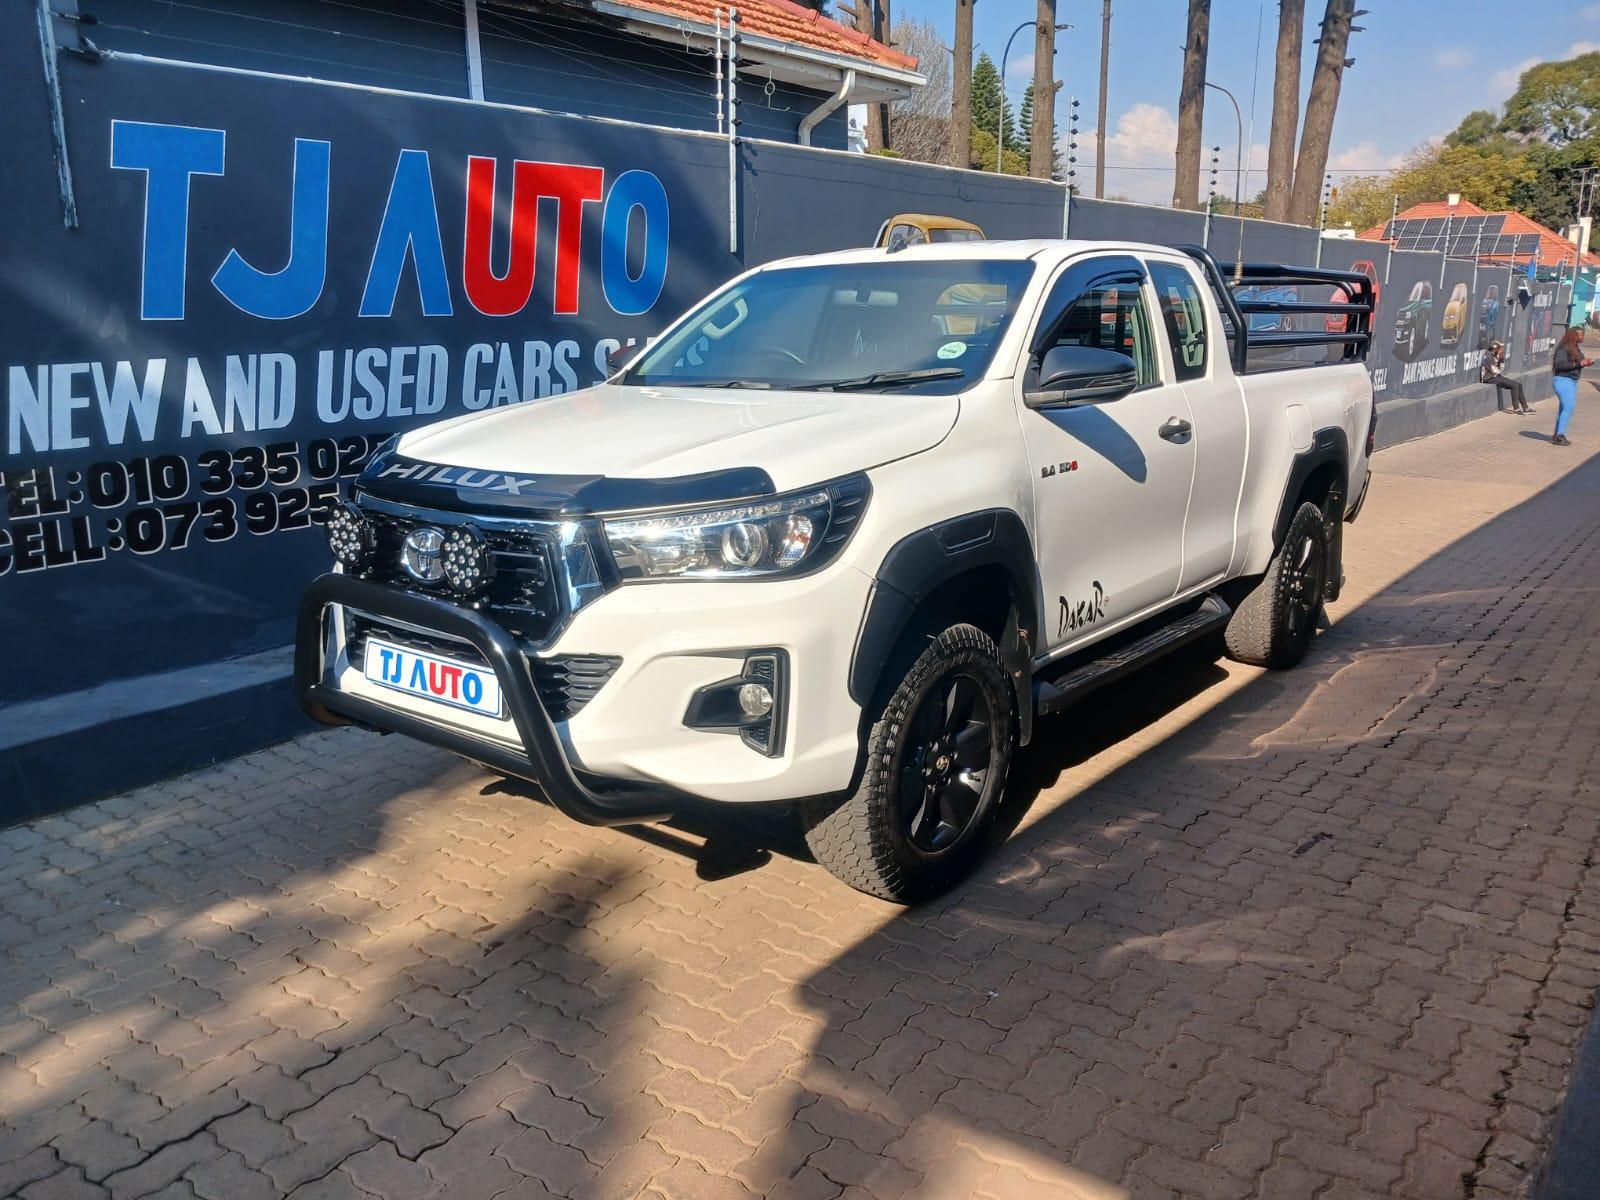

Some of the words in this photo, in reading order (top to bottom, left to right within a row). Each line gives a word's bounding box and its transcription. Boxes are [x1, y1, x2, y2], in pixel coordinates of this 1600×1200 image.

[111, 119, 331, 320] TJ
[358, 149, 670, 317] AUTO
[8, 358, 166, 455] NEW
[181, 352, 297, 438] AND
[316, 345, 448, 424] USED
[462, 339, 581, 411] CARS
[0, 455, 190, 521] EL:010
[198, 441, 301, 495] 335
[378, 463, 537, 495] HILUX
[380, 648, 403, 684] TJ
[409, 658, 483, 705] AUTO
